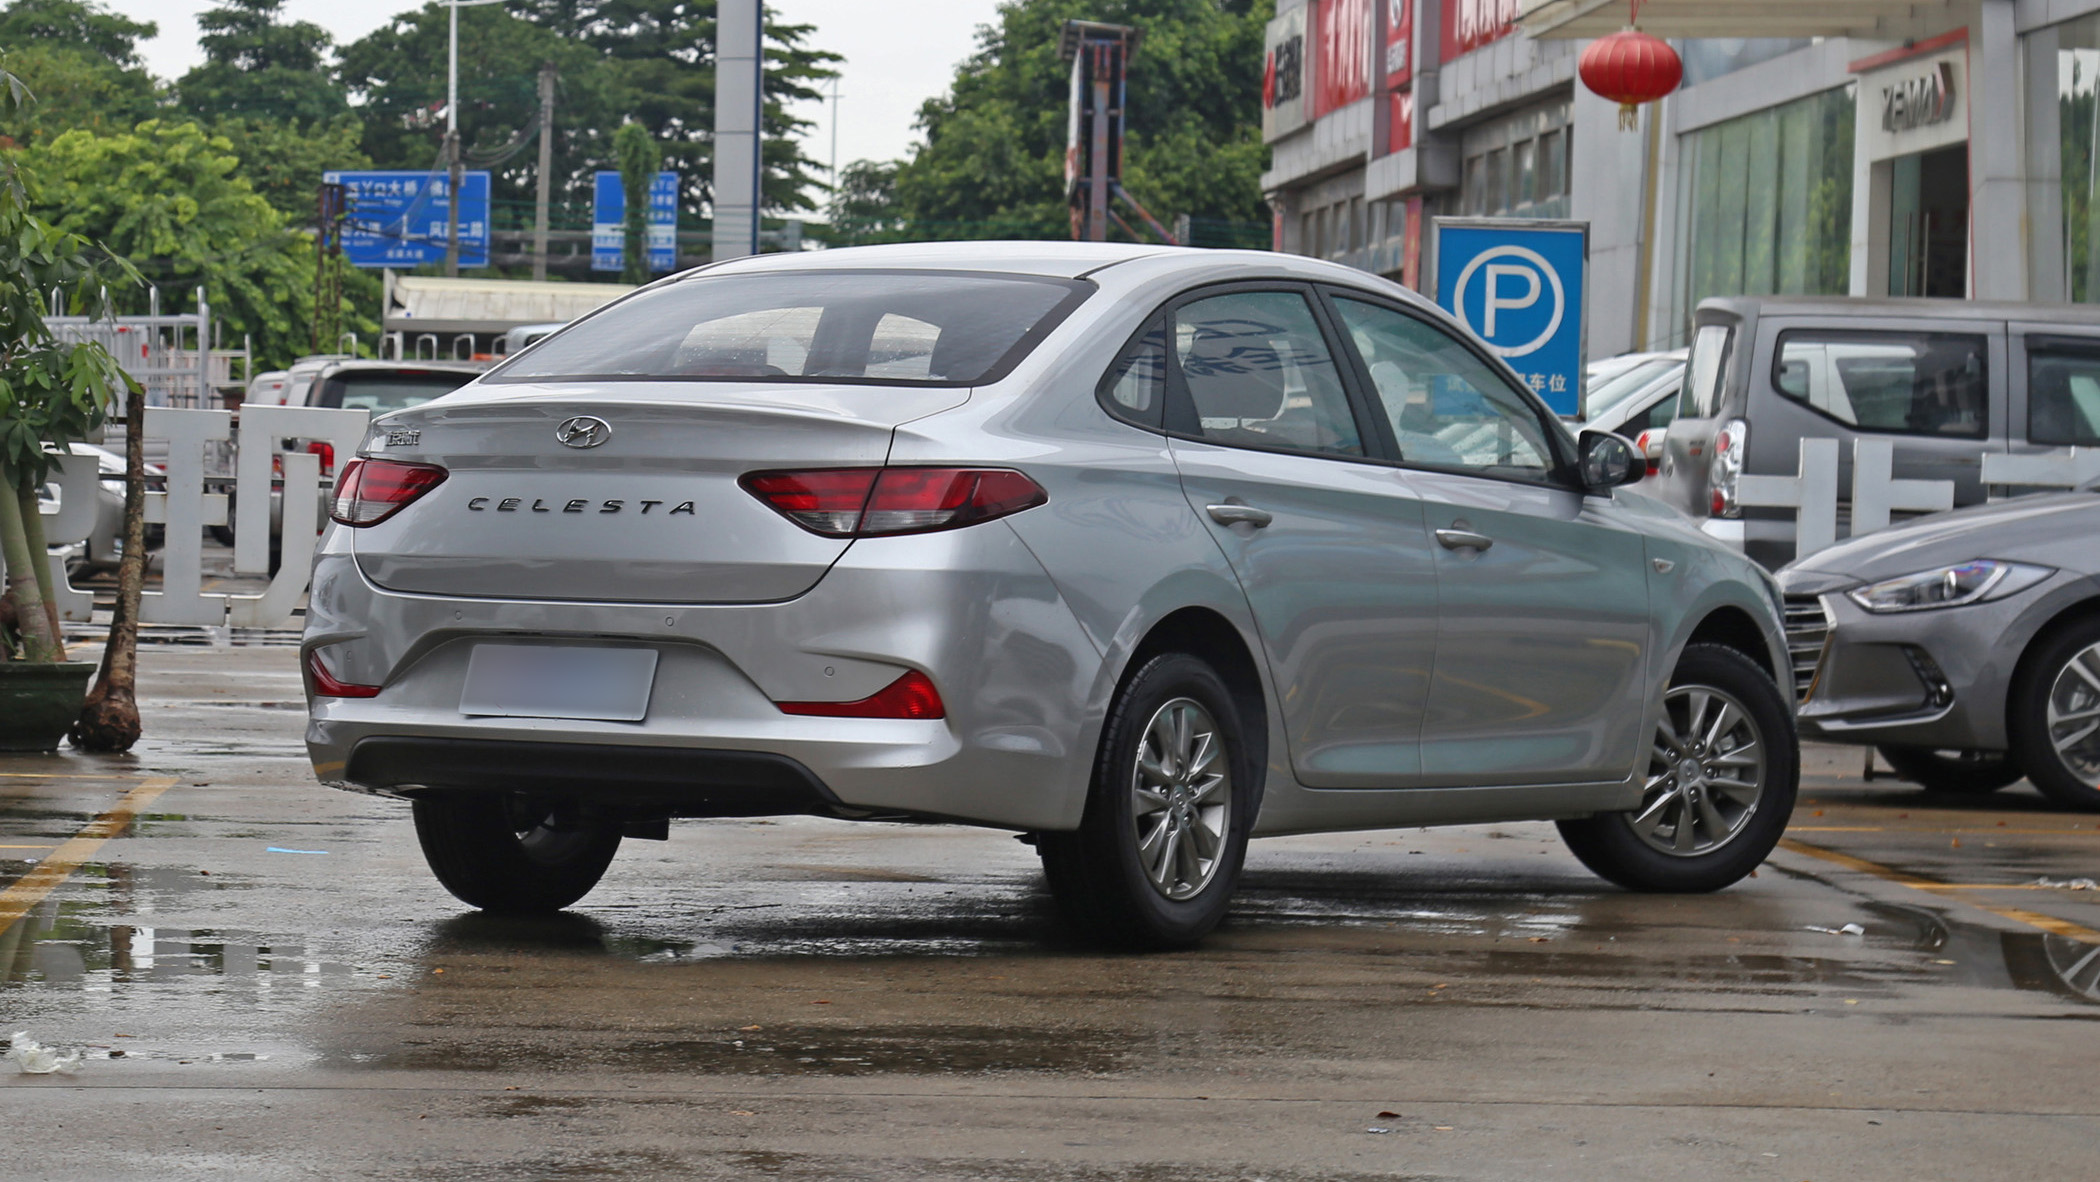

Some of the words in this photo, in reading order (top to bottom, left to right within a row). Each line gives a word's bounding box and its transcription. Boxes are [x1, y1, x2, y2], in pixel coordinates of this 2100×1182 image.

[1484, 263, 1541, 338] P
[1517, 372, 1567, 393] 车位
[467, 497, 696, 515] CELESTA
